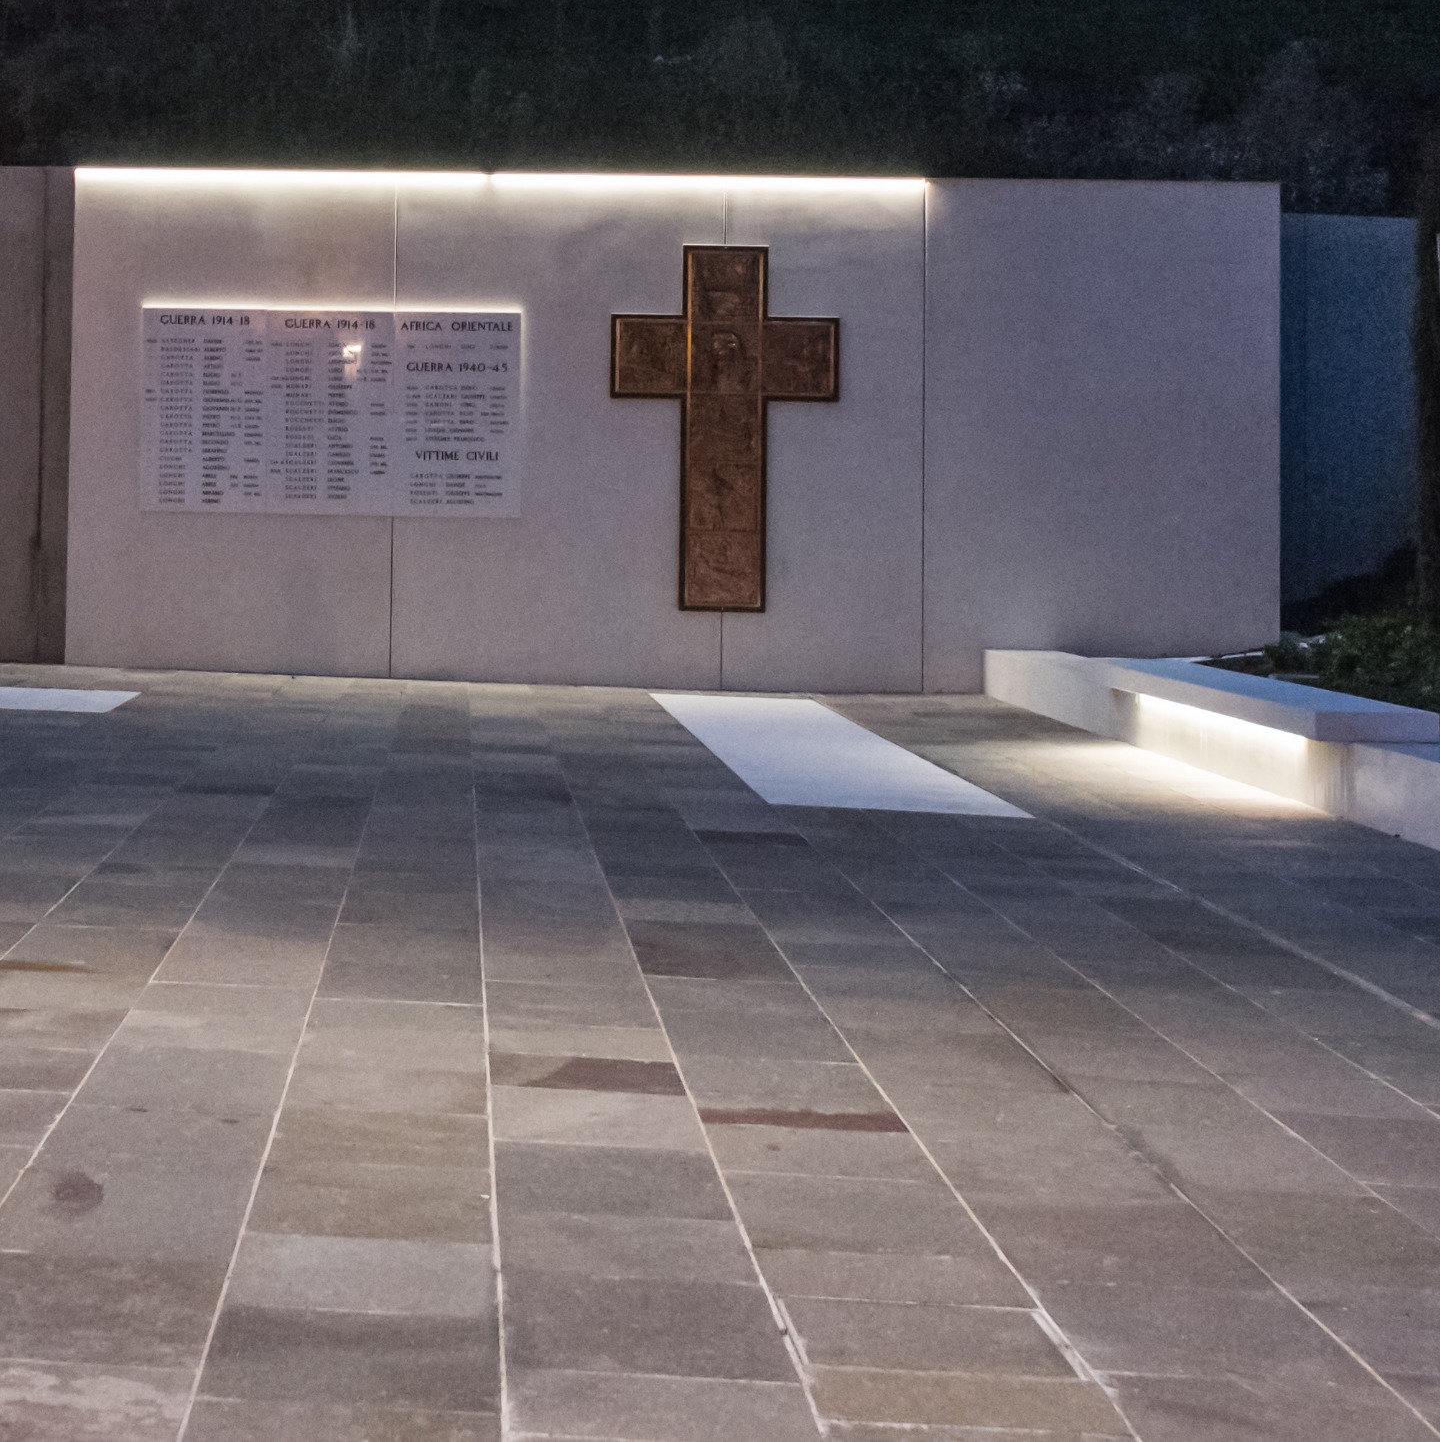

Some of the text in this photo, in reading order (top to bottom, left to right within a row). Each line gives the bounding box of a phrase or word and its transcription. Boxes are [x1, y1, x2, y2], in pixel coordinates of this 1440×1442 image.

[160, 315, 205, 325] GUERRA
[285, 318, 331, 329] GUERRA
[401, 322, 513, 332] AFRICA ORIENTALE
[406, 363, 508, 372] GUERRA 1940-45
[415, 451, 499, 461] VITTIME CIVILI
